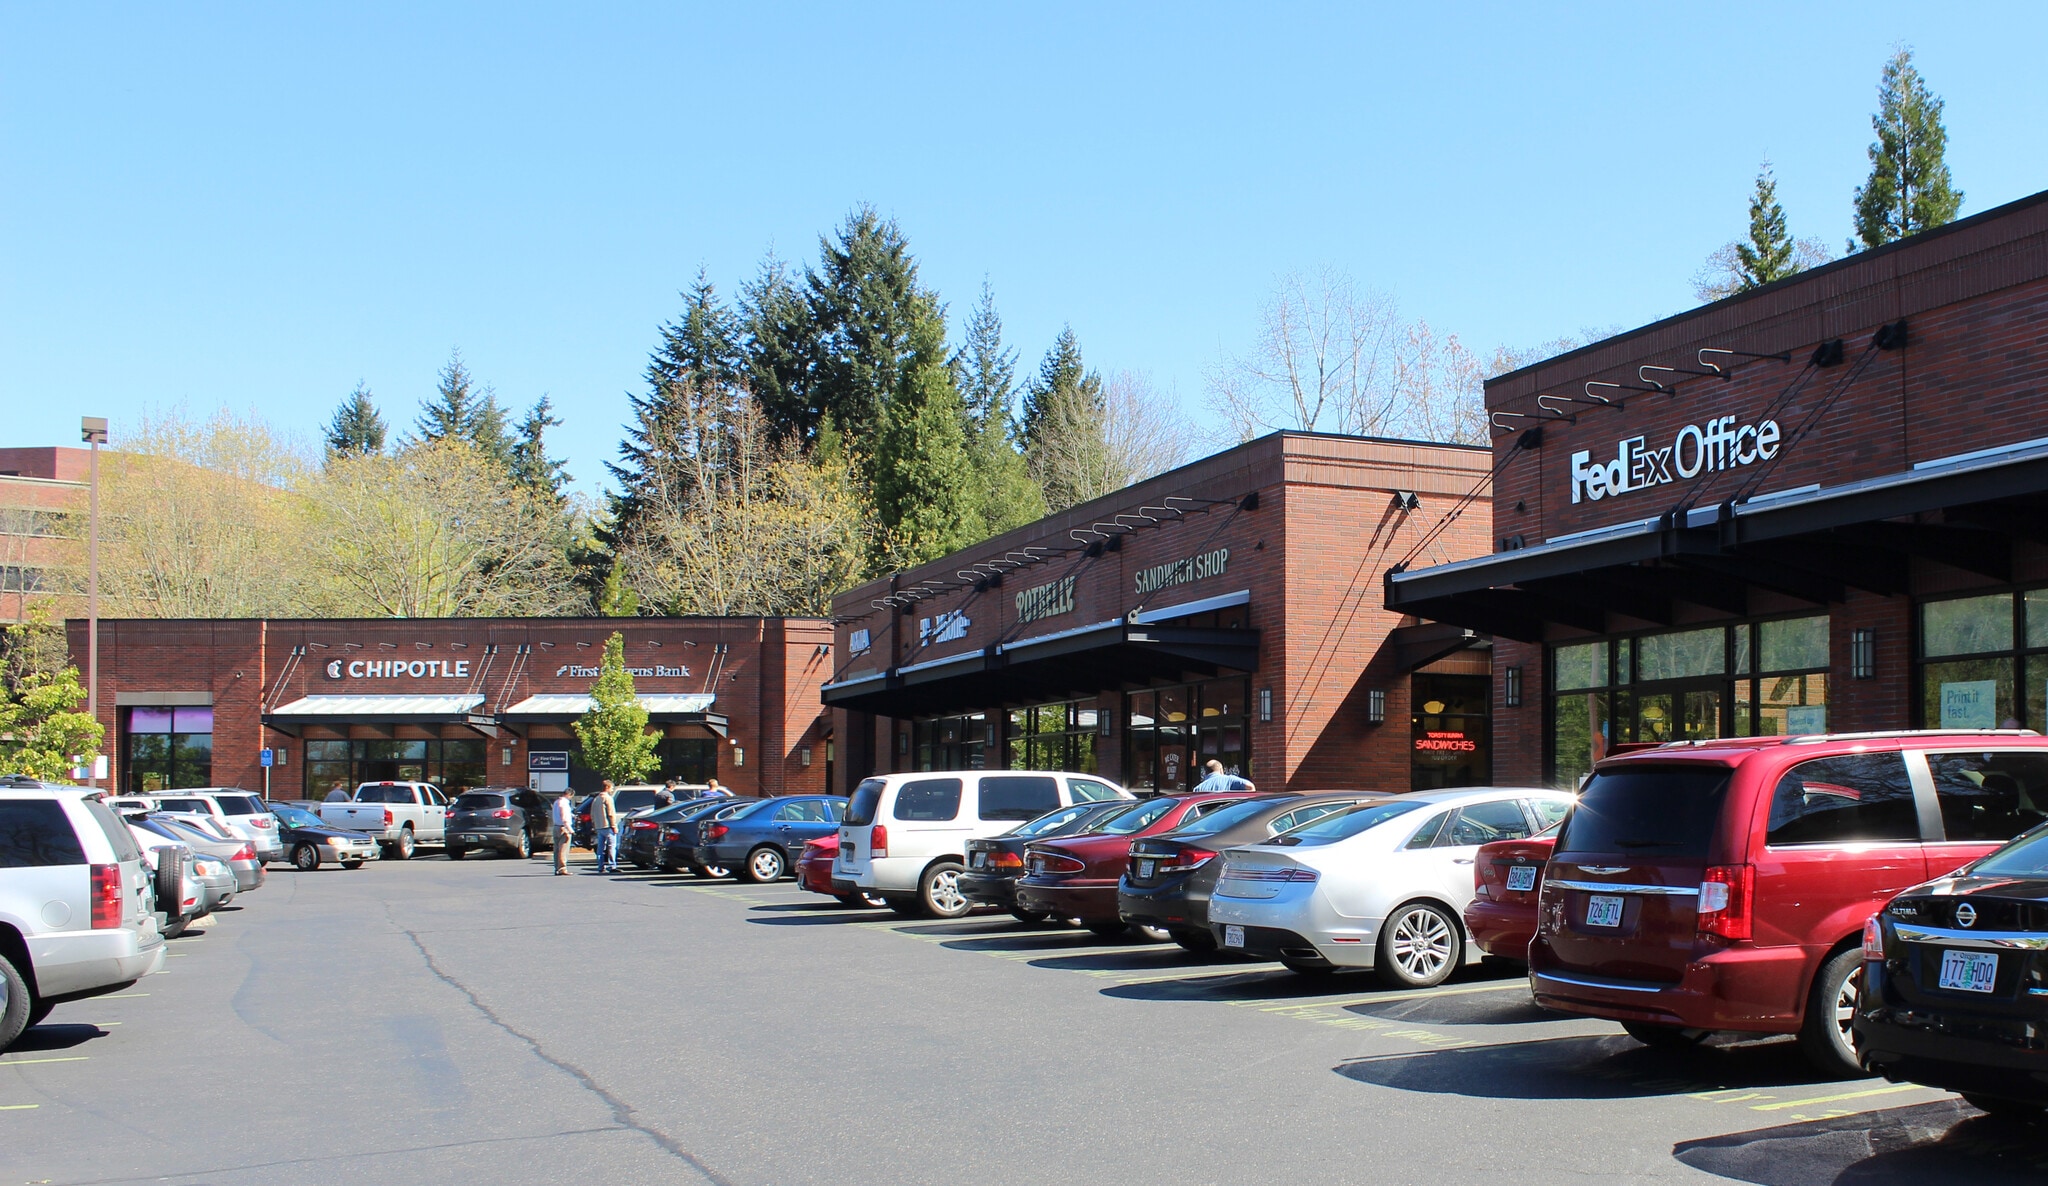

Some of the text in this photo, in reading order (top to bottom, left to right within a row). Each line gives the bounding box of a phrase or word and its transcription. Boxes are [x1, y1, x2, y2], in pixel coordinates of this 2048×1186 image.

[1571, 415, 1781, 504] FedEx Office
[1135, 548, 1228, 594] SANDWICH SHOP
[1015, 575, 1075, 623] POTBELLY
[348, 660, 470, 678] CHIPOTLE
[568, 665, 599, 677] First
[655, 665, 690, 677] Bank
[1946, 689, 1979, 704] Print it
[1415, 740, 1476, 750] SANDWICHES
[1590, 902, 1620, 920] 726 FTL
[1944, 959, 1994, 982] 177 HDQ
